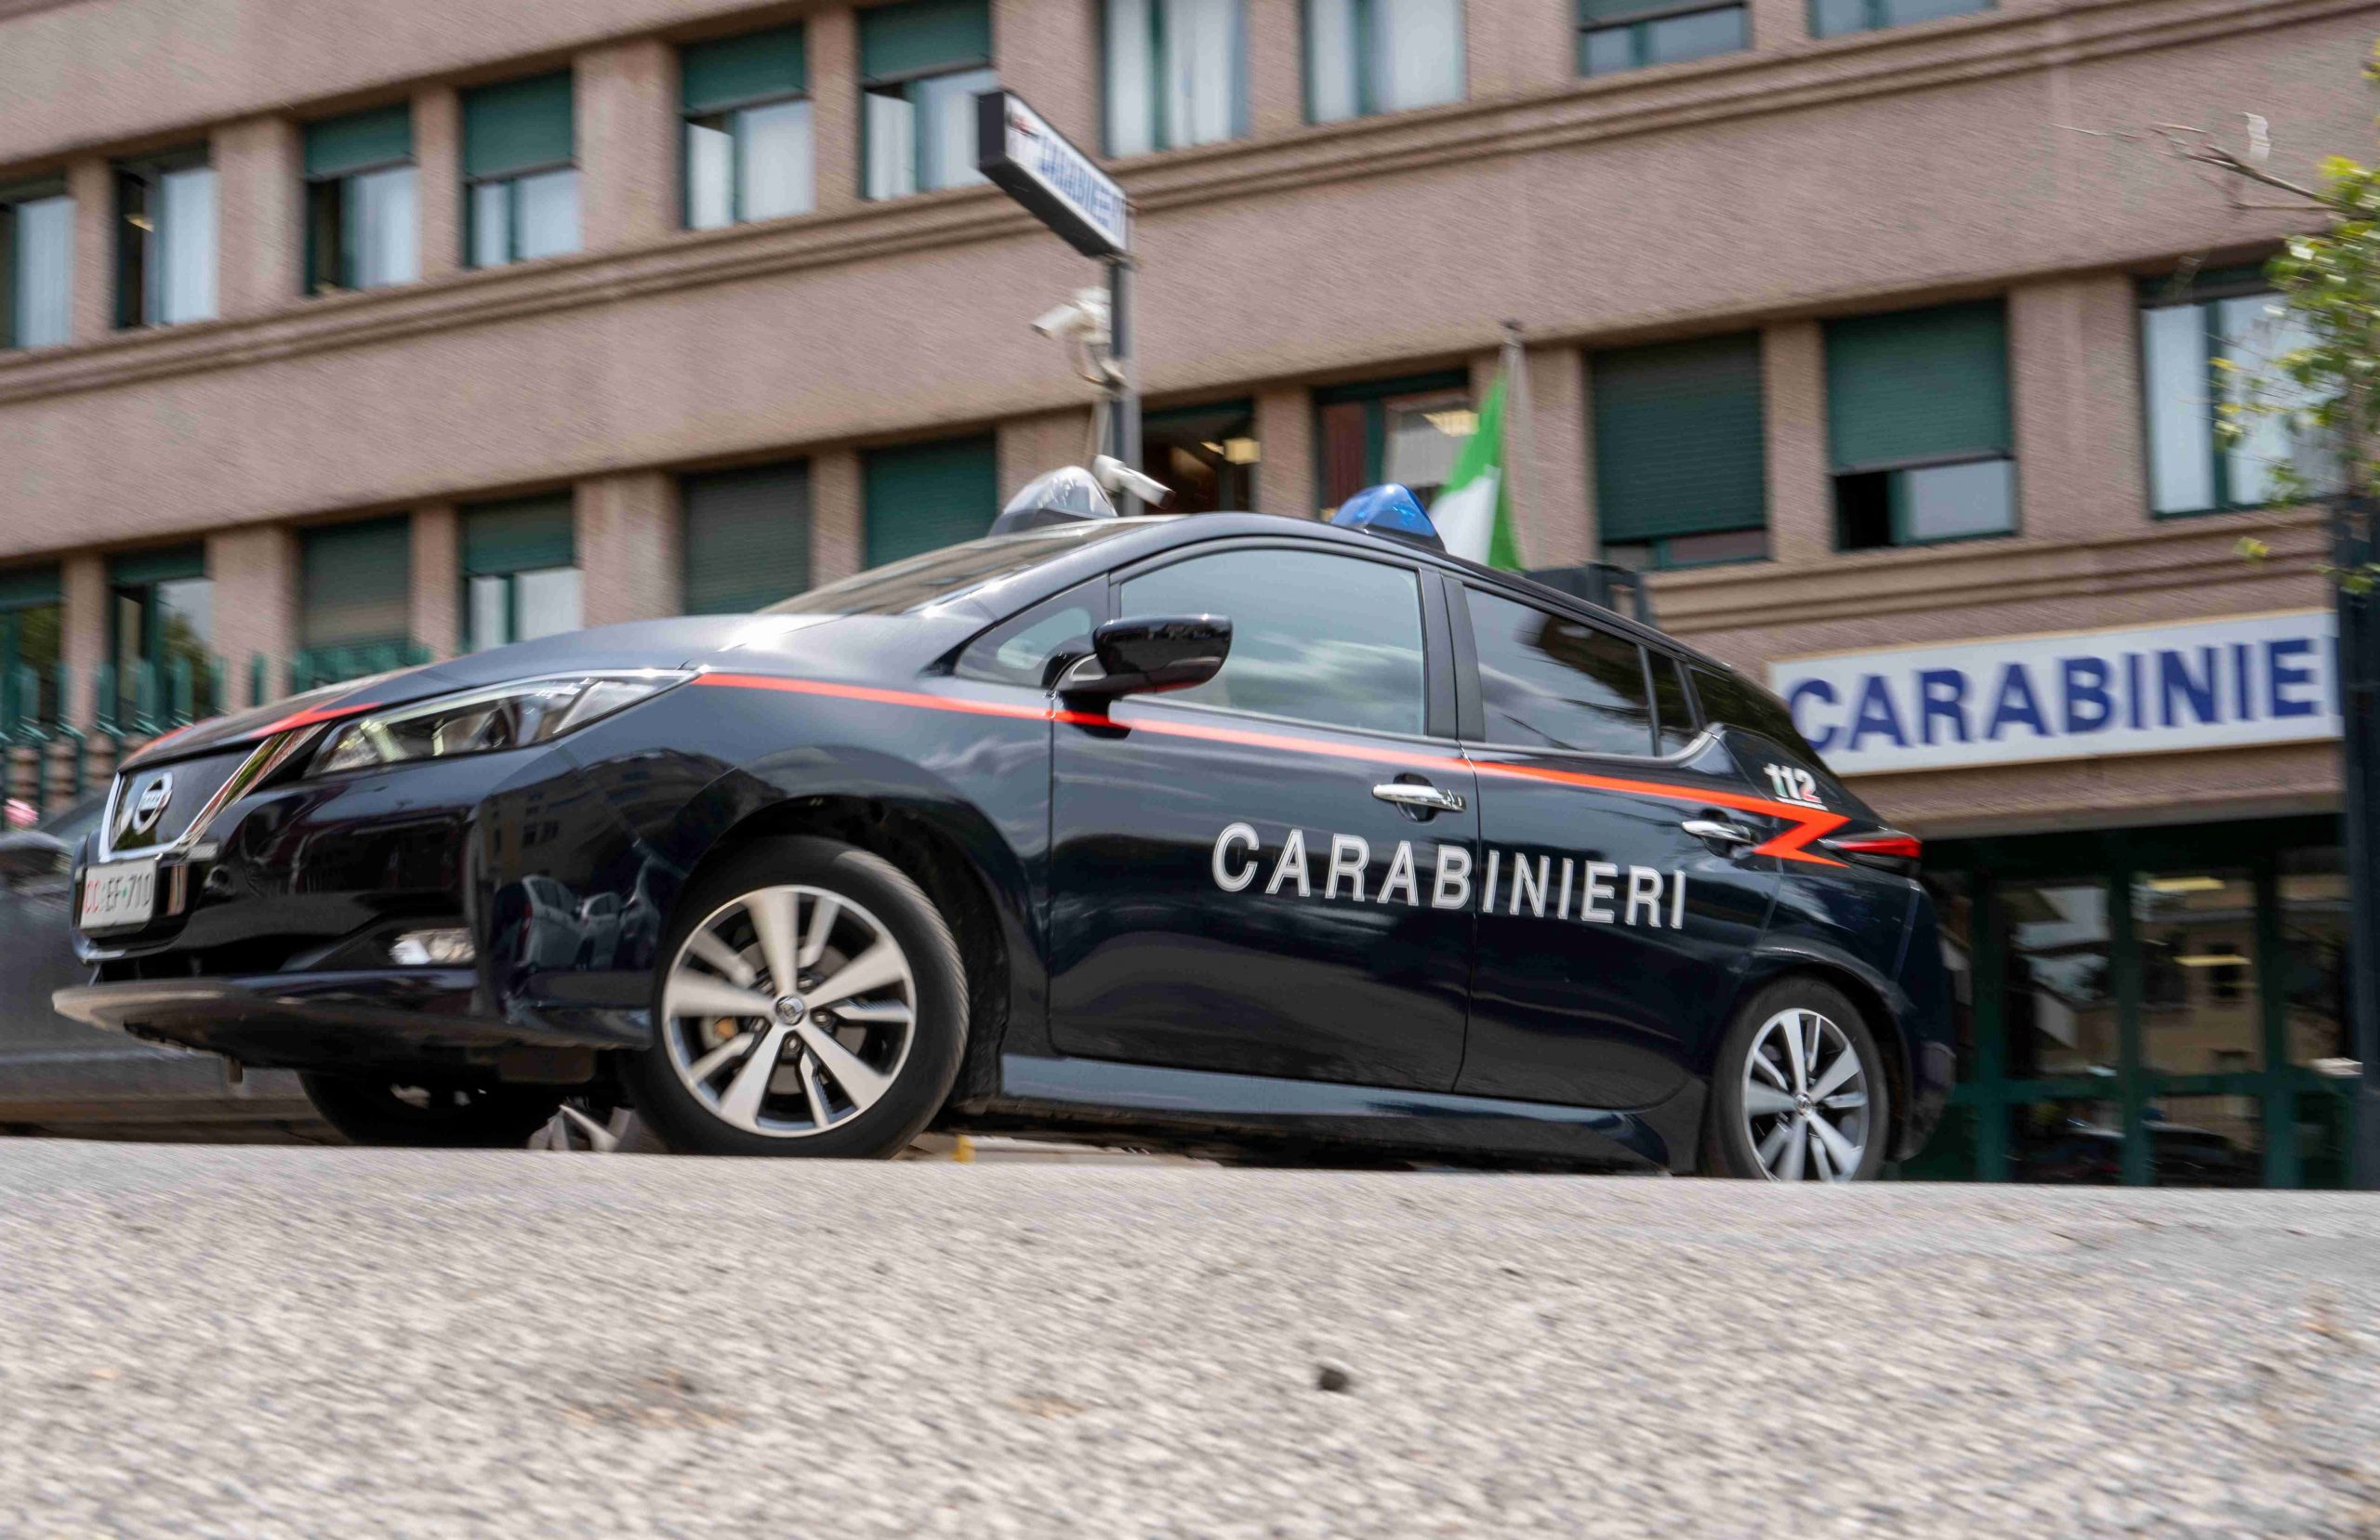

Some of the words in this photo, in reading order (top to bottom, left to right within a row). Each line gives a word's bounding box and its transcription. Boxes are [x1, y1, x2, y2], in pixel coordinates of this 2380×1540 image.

[1788, 636, 2343, 756] CARABINIE
[1763, 763, 1822, 804] 112
[1212, 822, 1686, 929] CARABINIERI
